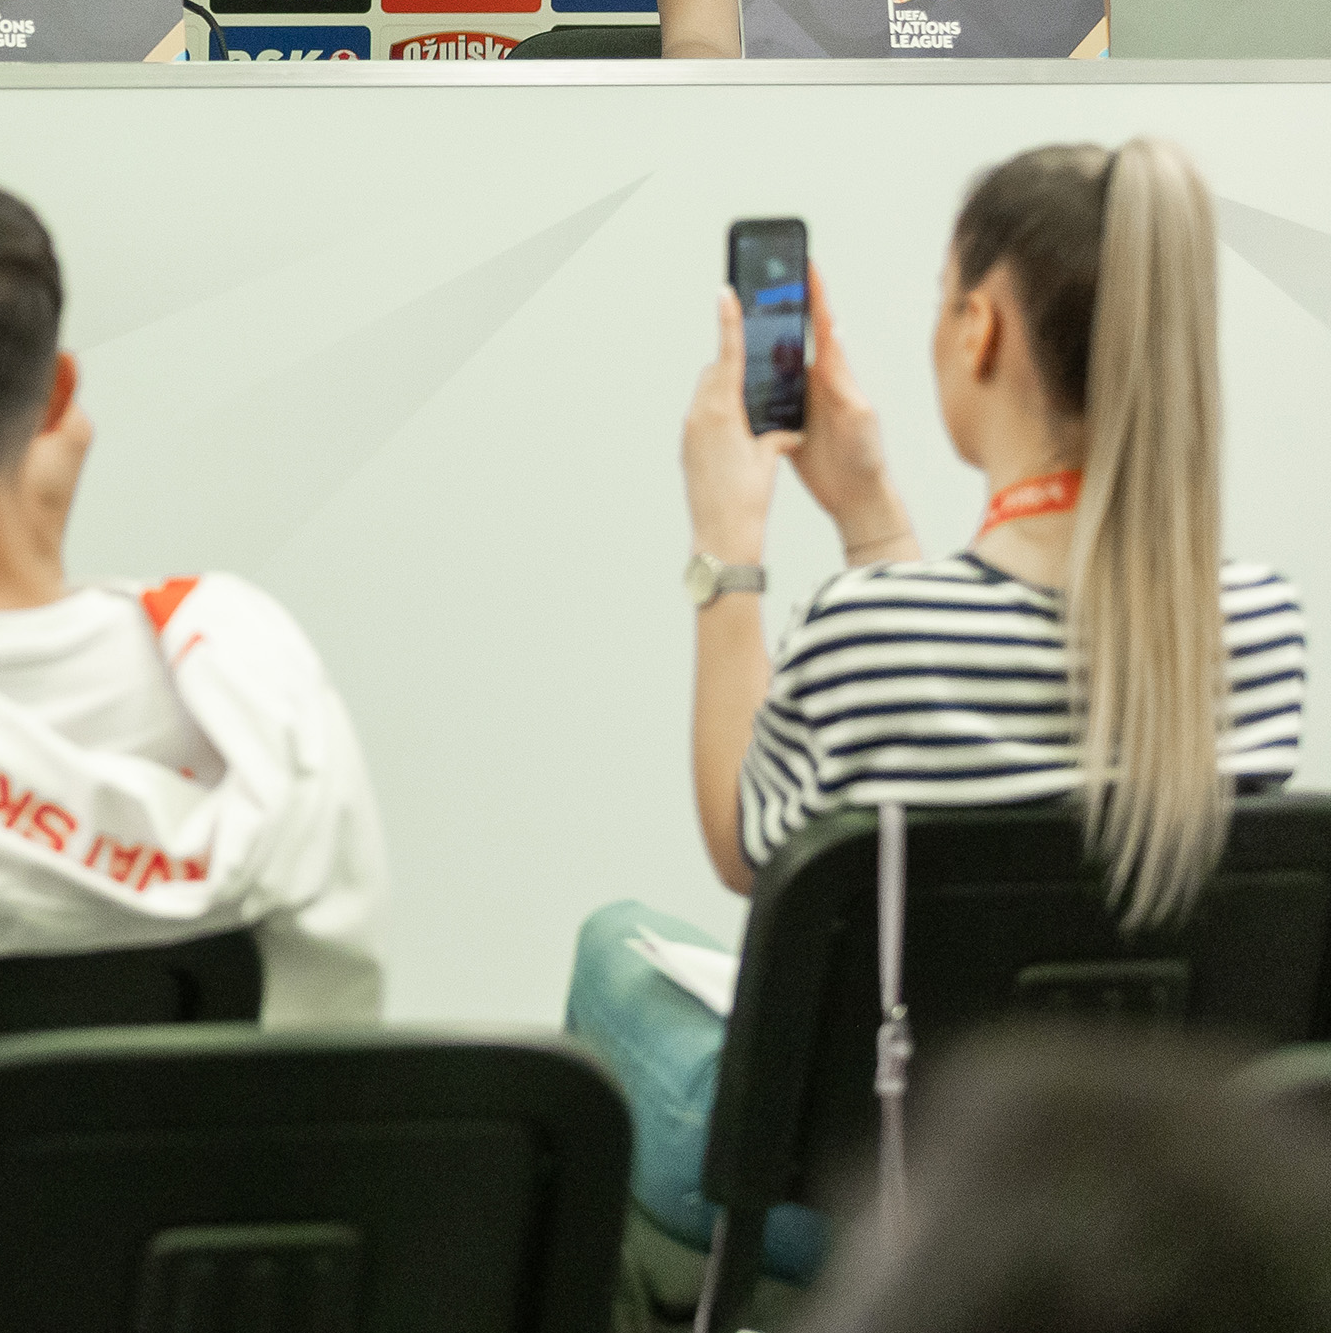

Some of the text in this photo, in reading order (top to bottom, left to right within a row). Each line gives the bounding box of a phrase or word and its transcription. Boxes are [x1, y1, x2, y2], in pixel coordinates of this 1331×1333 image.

[896, 10, 927, 22] UEFA
[890, 21, 961, 36] NATIONS
[891, 34, 953, 49] LEAGUE
